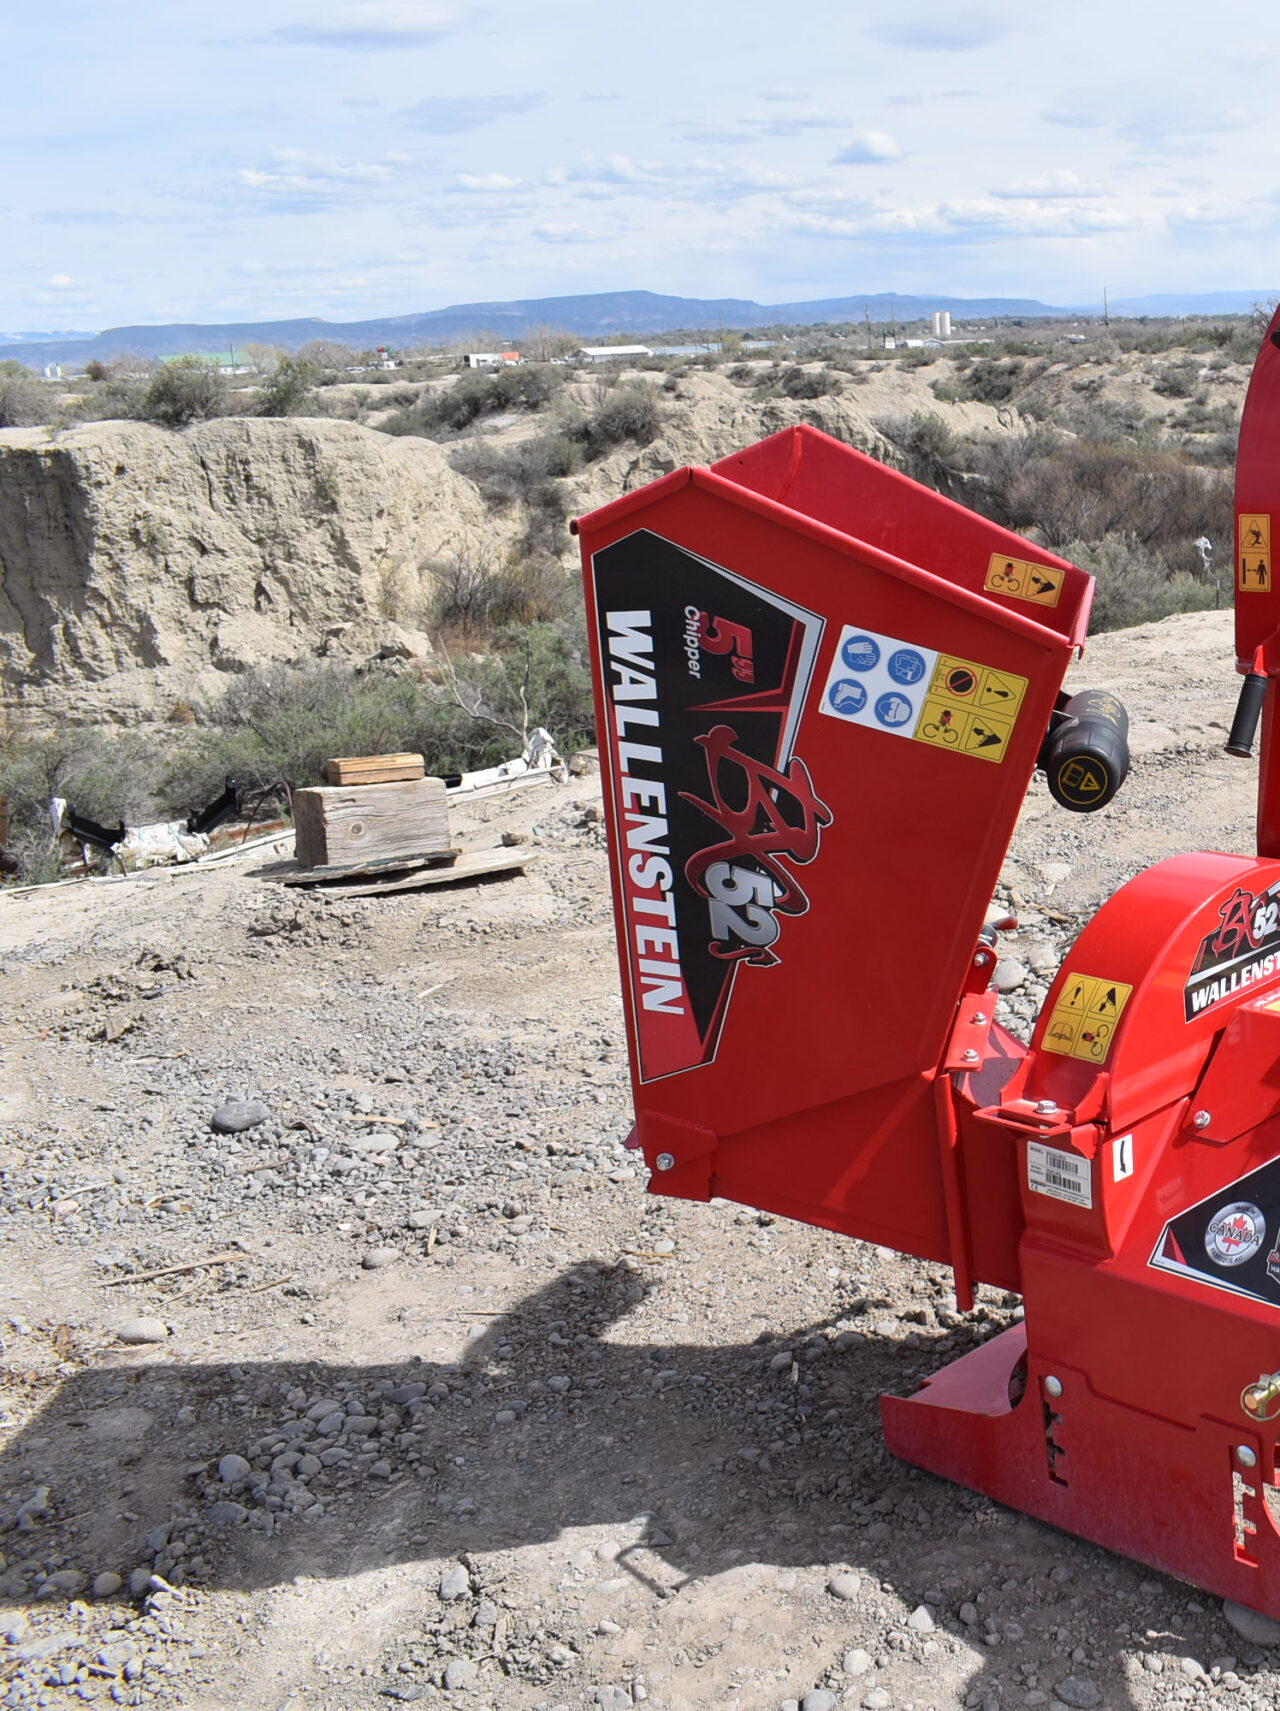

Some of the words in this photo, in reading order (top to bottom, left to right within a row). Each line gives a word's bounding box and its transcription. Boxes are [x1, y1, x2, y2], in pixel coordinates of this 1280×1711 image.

[683, 605, 702, 679] Chipper
[606, 610, 685, 1015] WALLENSTEIN
[1209, 1222, 1260, 1247] CANADA
